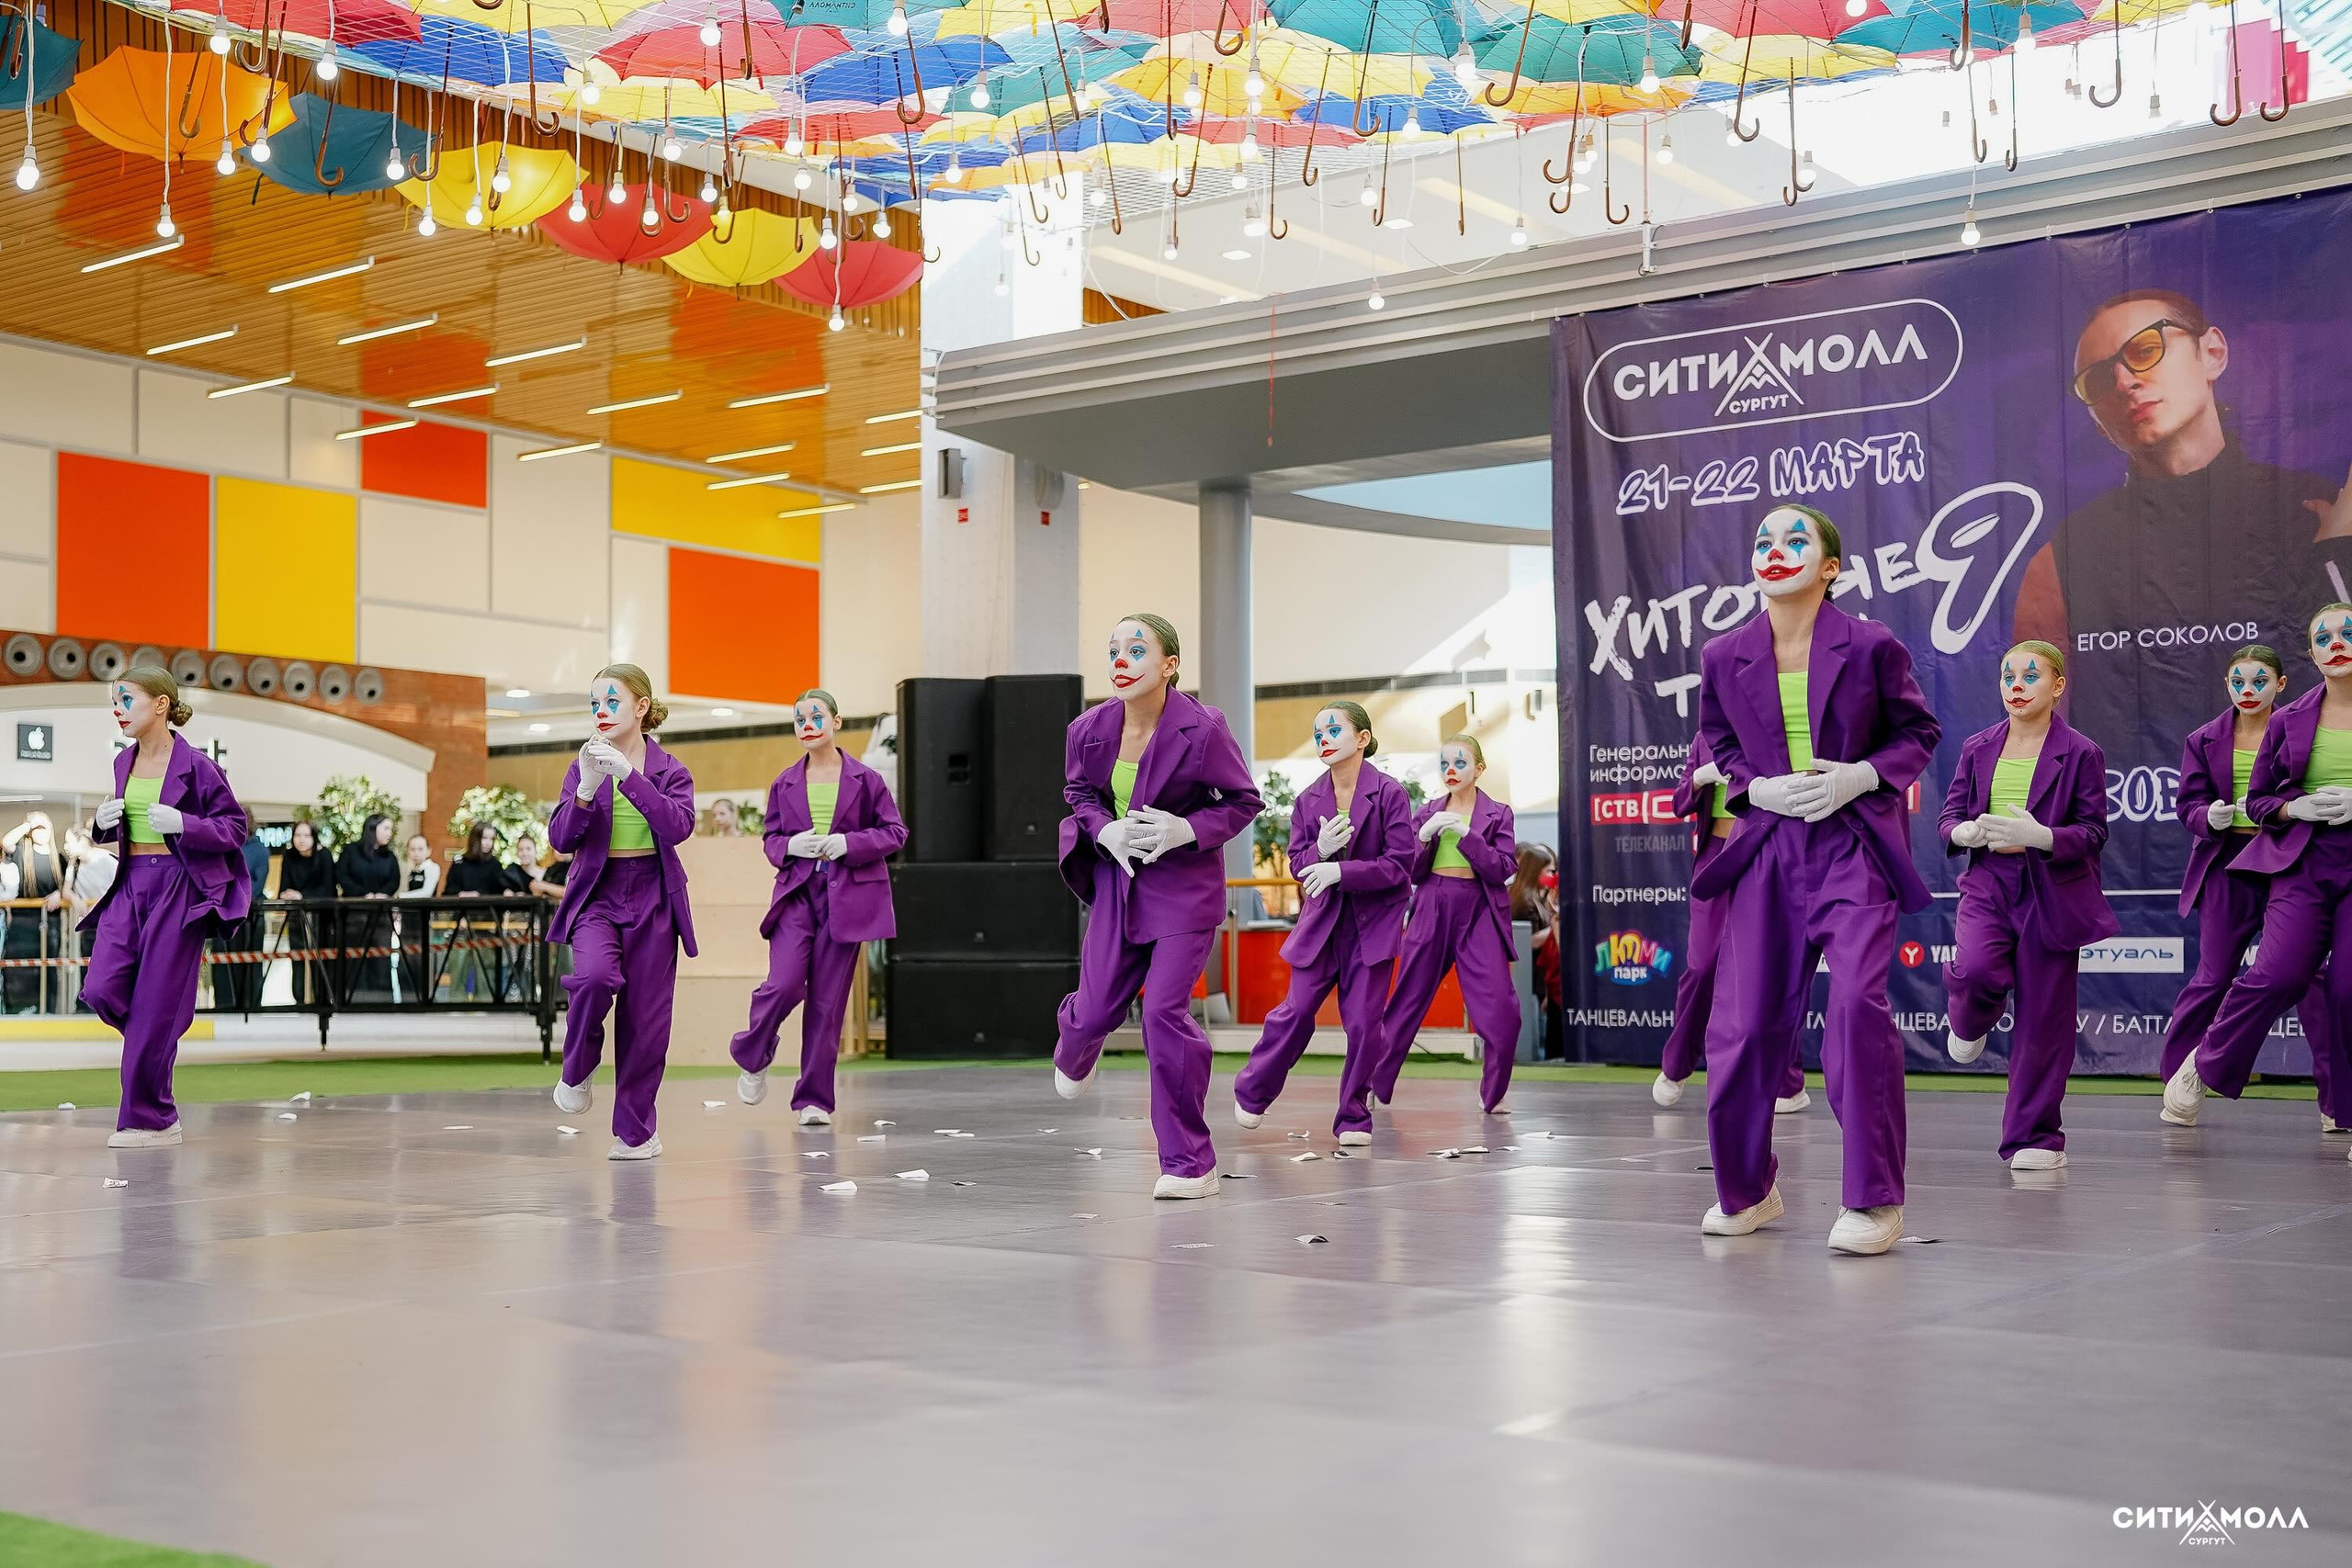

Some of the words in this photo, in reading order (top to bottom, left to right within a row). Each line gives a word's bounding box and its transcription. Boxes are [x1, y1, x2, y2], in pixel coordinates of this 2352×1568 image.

[1613, 350, 1738, 400] СИТИ
[1780, 323, 1928, 378] МОЛЛ
[1728, 393, 1790, 414] СУРГУТ
[1615, 456, 1760, 516] 21-22
[1770, 431, 1925, 498] МАРТА
[2077, 631, 2131, 652] ЕГОР
[2137, 622, 2259, 648] СОКОЛОВ
[1589, 743, 1693, 764] Генеральн
[1615, 834, 1686, 853] ТЕЛЕКАНАЛ
[1592, 885, 1687, 907] Партнеры:
[1613, 965, 1647, 982] парк
